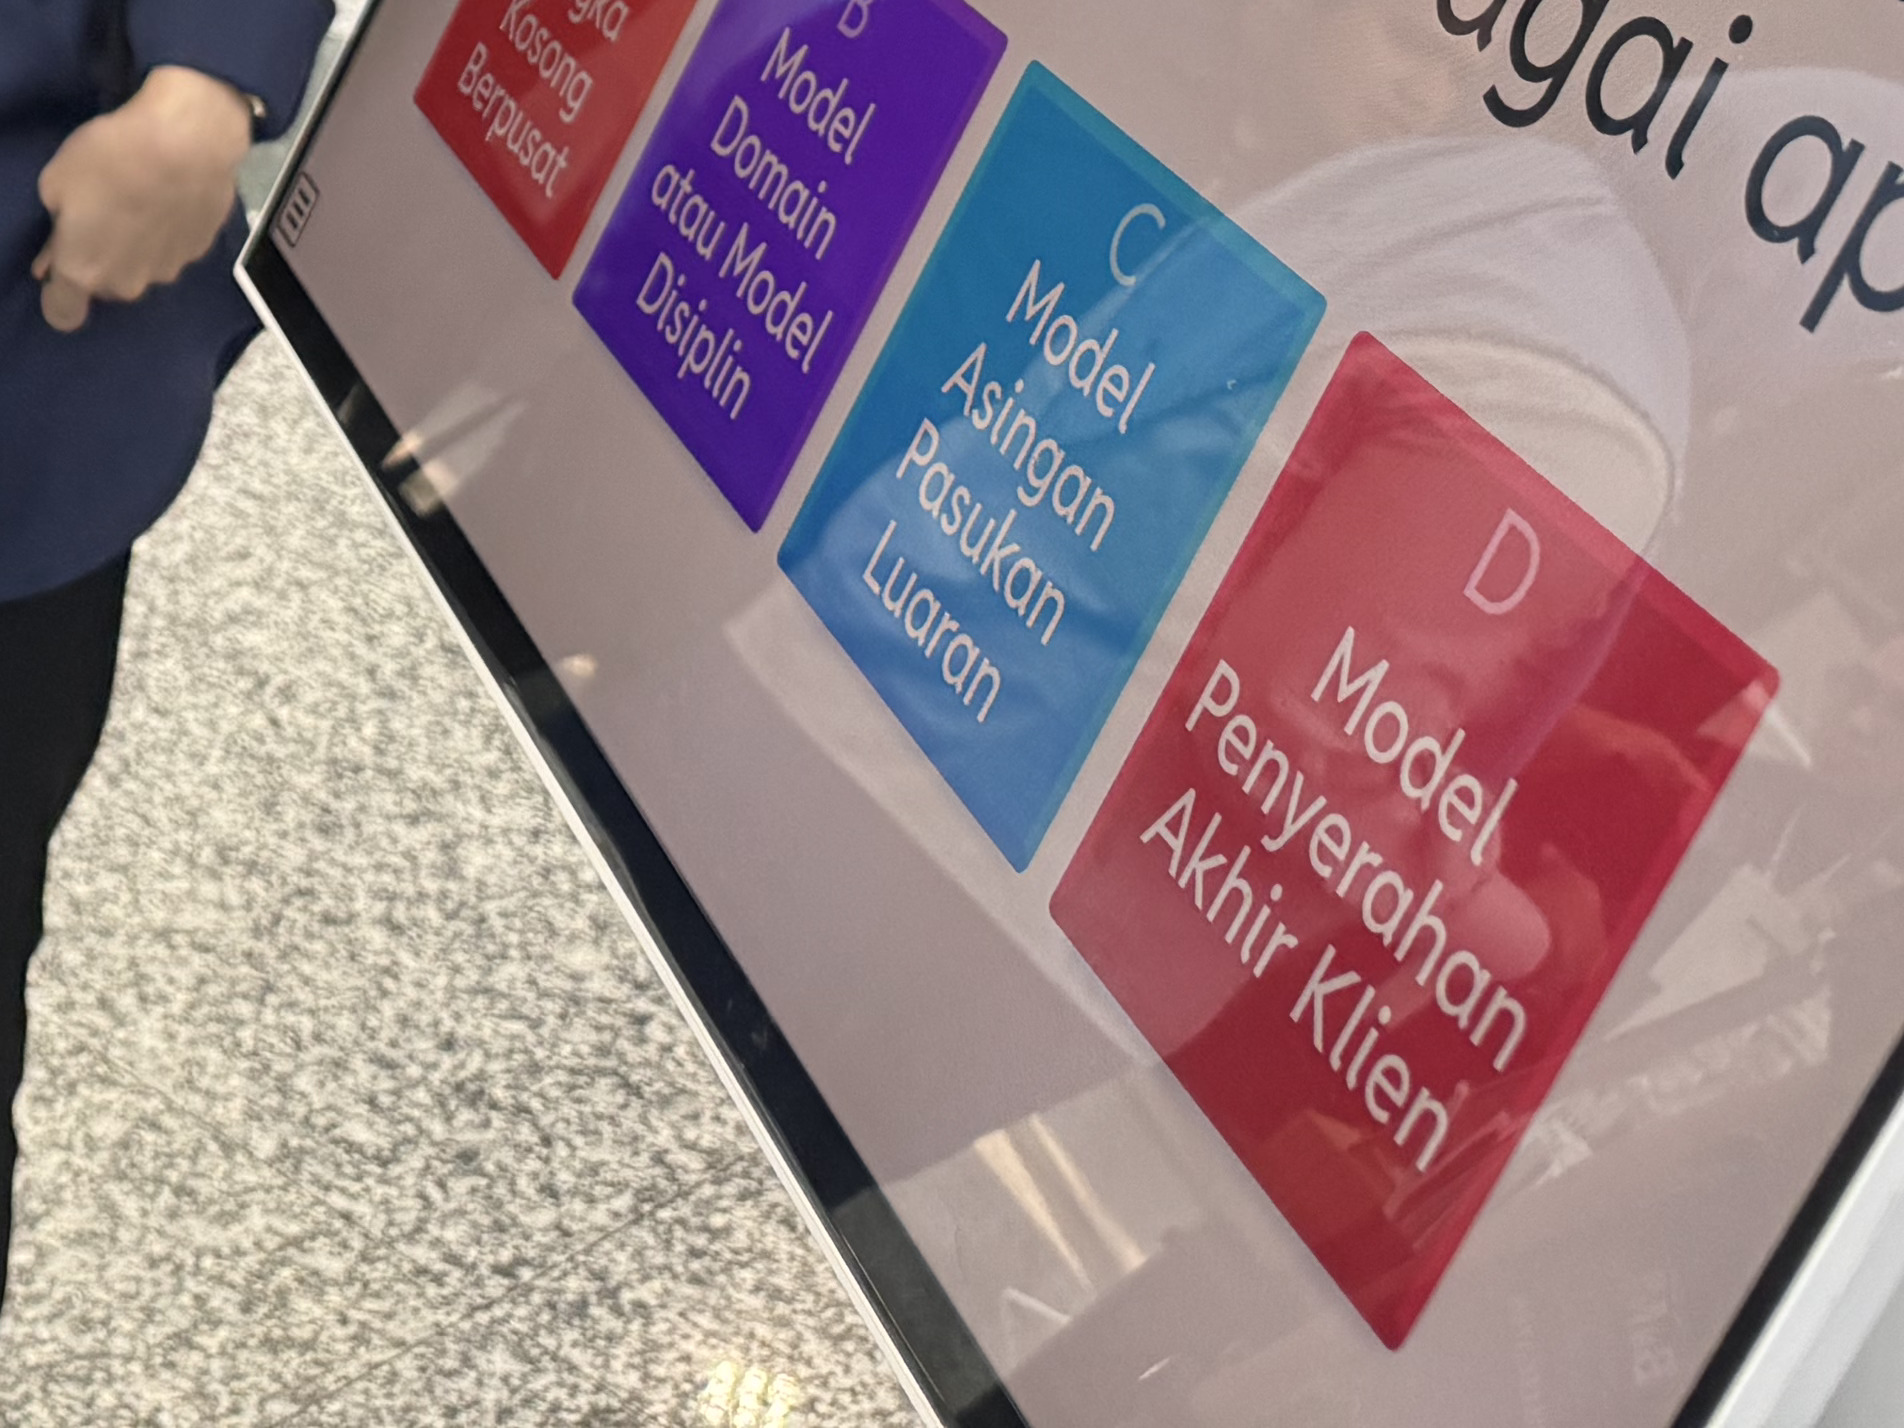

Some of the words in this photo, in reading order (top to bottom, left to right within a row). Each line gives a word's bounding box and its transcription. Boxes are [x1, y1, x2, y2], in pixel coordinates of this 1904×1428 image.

[458, 46, 568, 199] Berpusat
[711, 95, 836, 259] Domain
[761, 28, 875, 164] Model
[636, 252, 750, 419] Disiplin
[652, 165, 718, 261] atau
[720, 222, 833, 373] Model
[1109, 203, 1165, 289] C
[1006, 259, 1155, 434] Model
[896, 418, 1064, 645] Pasukan
[941, 342, 1114, 551] Asingan
[863, 520, 1000, 721] Luaran
[1464, 508, 1540, 614] D
[1311, 626, 1517, 866] Model
[1185, 659, 1526, 1071] Penyerahan
[1140, 788, 1298, 977] Akhir
[1290, 944, 1449, 1172] Klien
